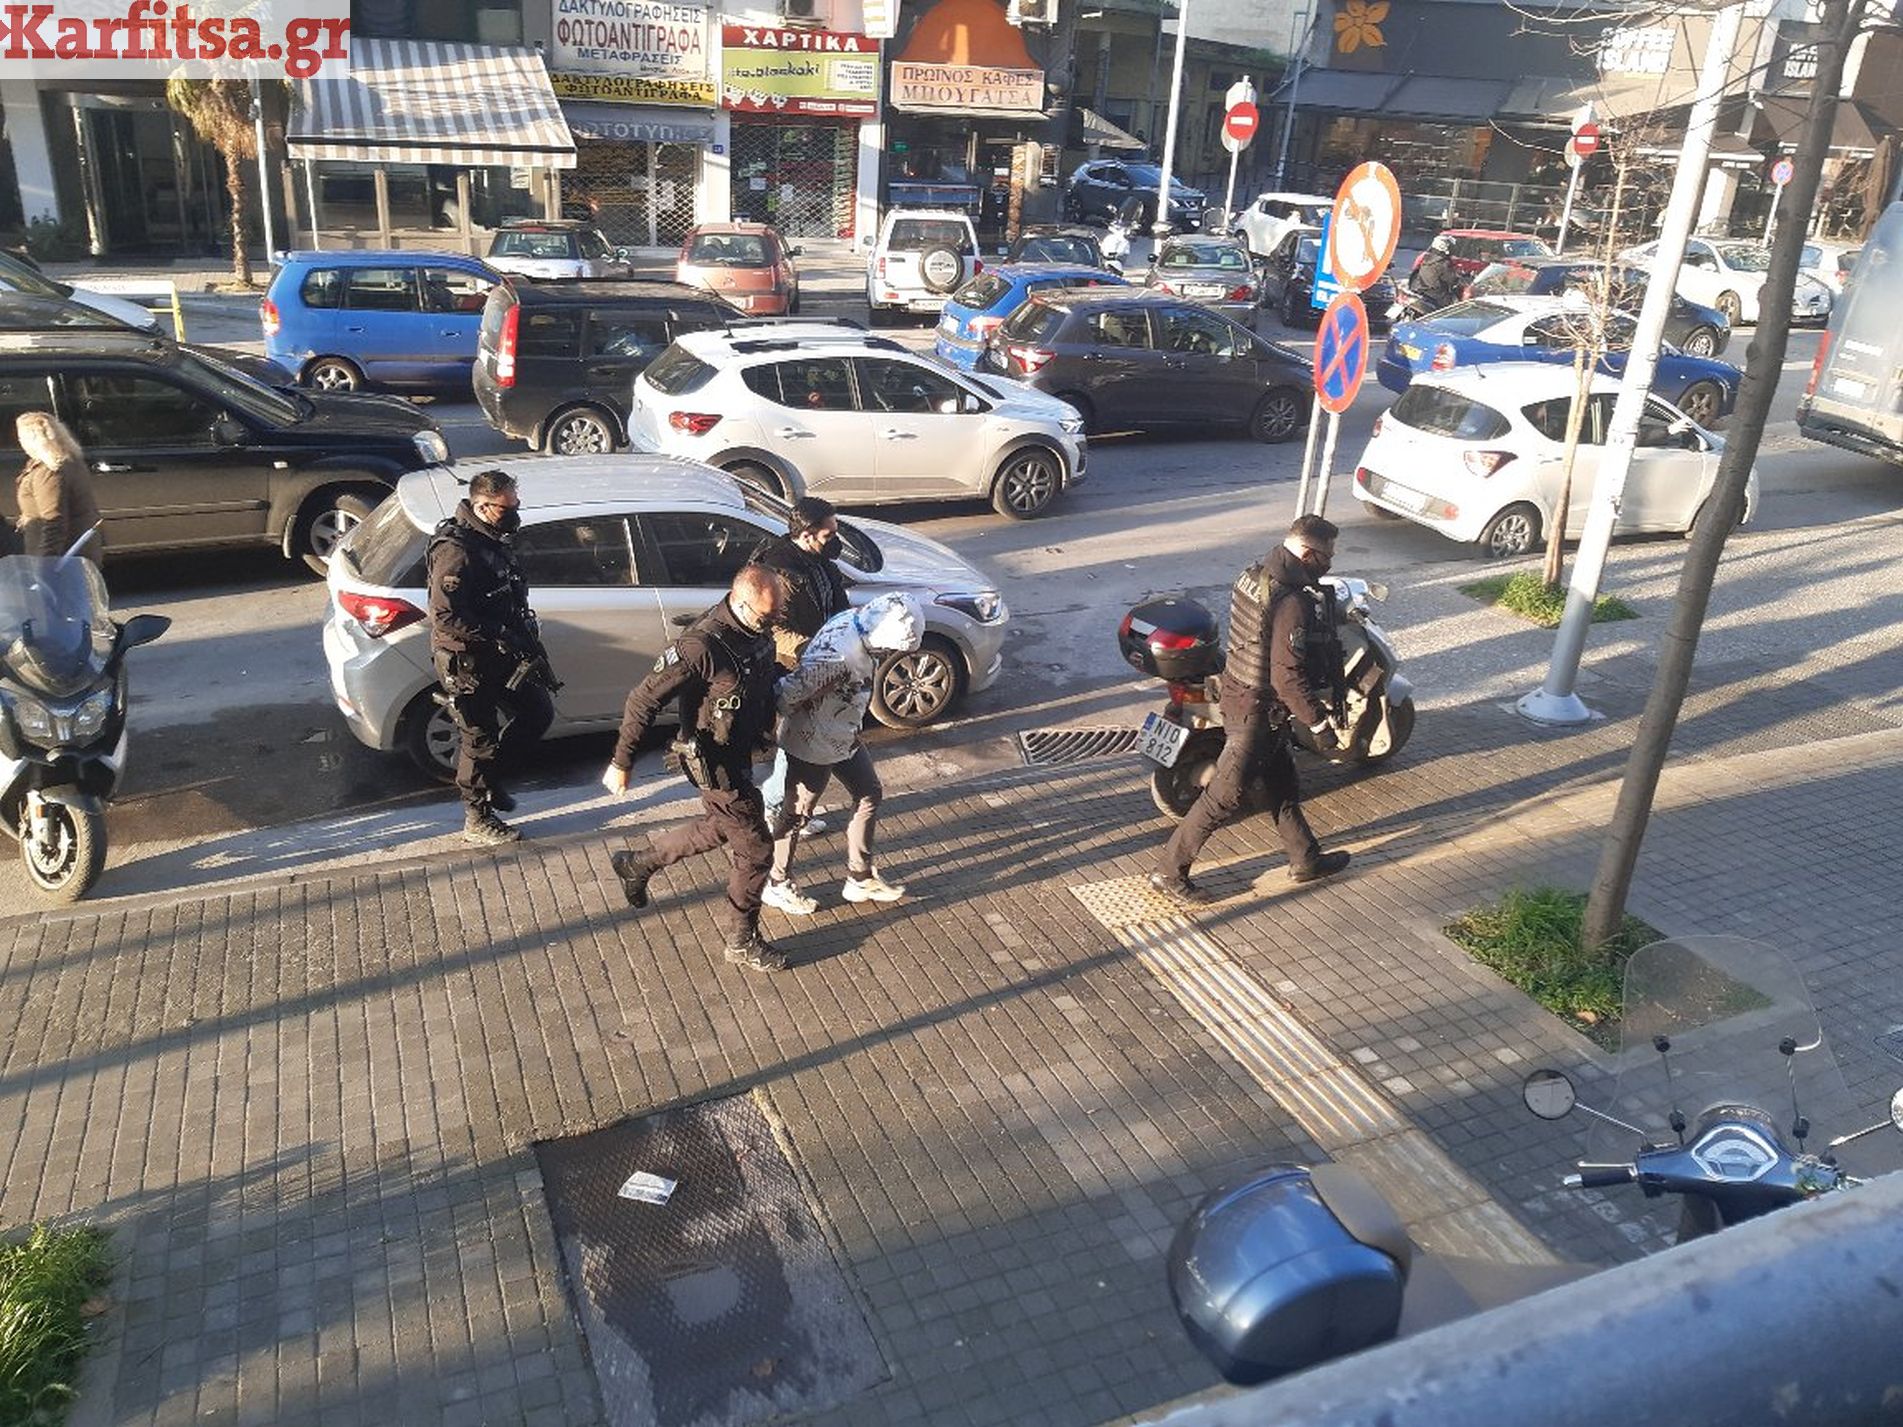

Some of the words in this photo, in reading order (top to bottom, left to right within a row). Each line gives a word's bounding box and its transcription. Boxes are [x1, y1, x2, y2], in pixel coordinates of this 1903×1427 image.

[557, 17, 702, 54] ΦΩΤΟΑΝΤΙΓΡΑΦΑ
[743, 29, 860, 52] ΧΑΡΤΙΚΑ
[577, 47, 682, 65] ΜΕΤΑΦΡΑΣΕΙΣ
[902, 67, 974, 83] ΠΡΩΙΝΟΣ
[982, 71, 1034, 87] ΚΑΦΕΣ
[901, 85, 1034, 106] ΜΠΟΥΓΑΤΣΑ
[1145, 738, 1172, 763] 812
